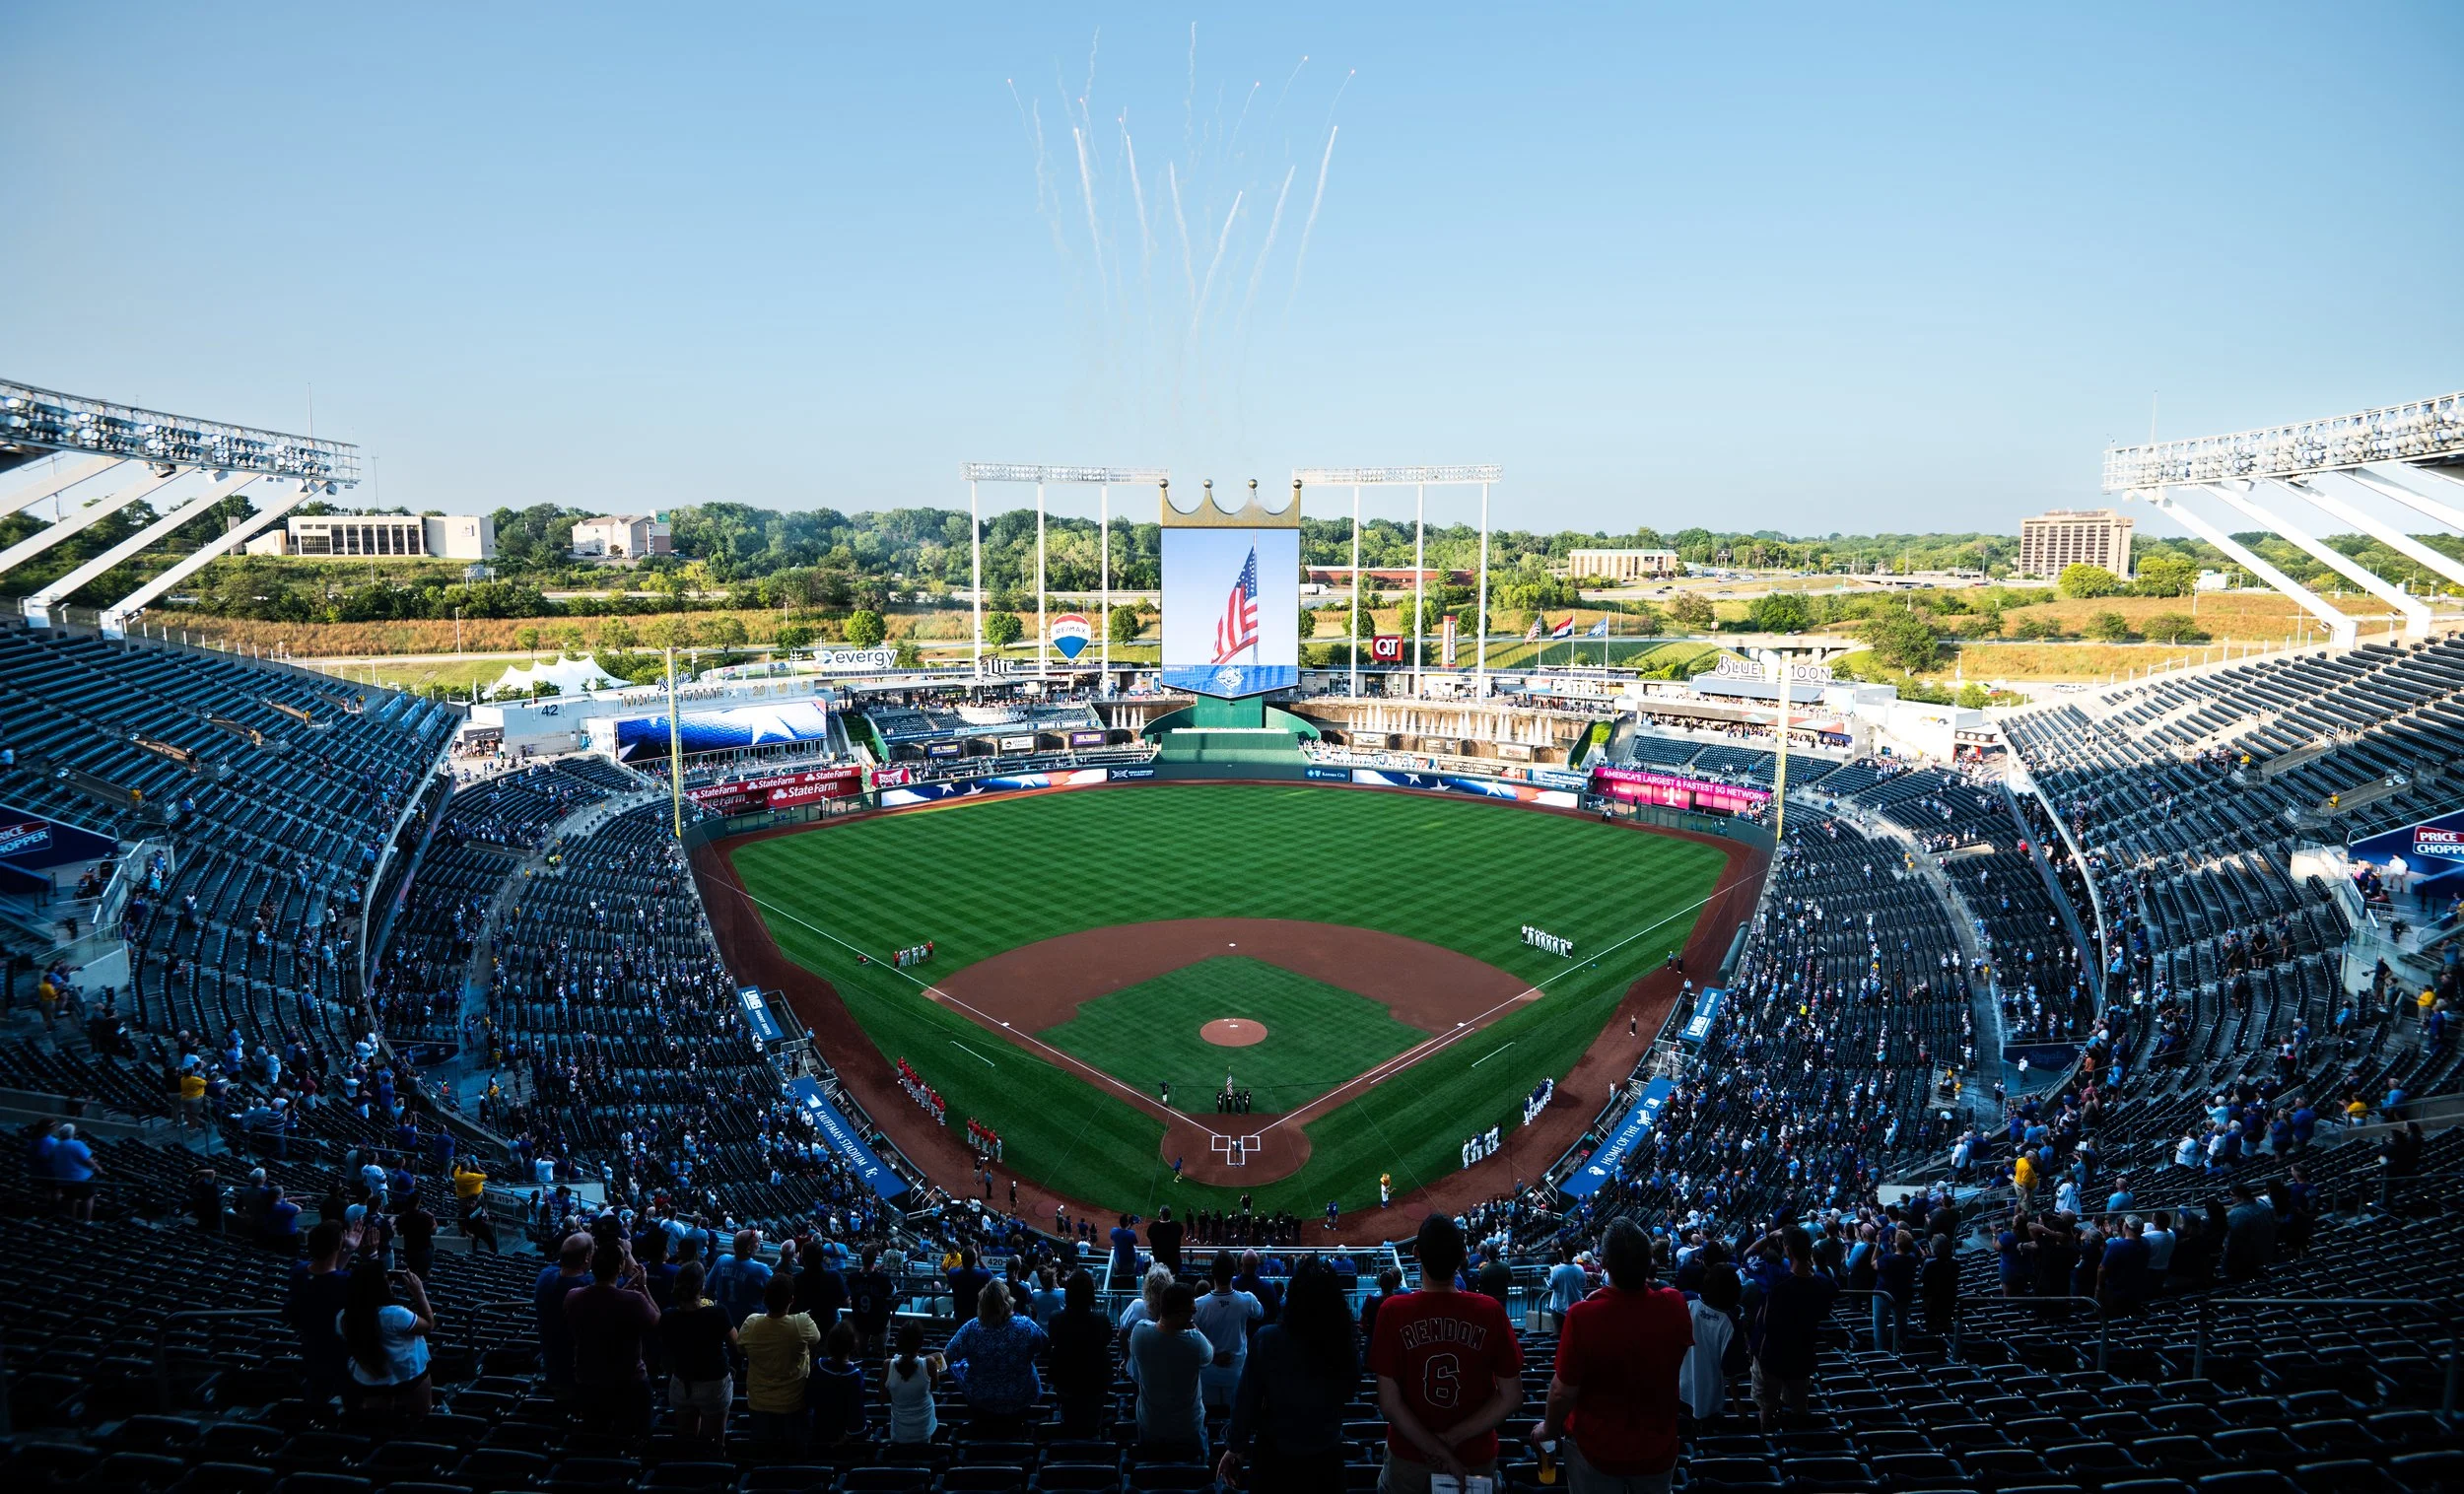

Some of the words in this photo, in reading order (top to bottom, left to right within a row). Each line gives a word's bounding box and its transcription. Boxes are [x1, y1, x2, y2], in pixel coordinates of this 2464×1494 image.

[1056, 626, 1086, 635] RE/MAX
[1375, 638, 1399, 656] QT
[835, 650, 896, 668] evergy
[987, 658, 1015, 677] Lite
[1716, 655, 1759, 676] BLUE
[753, 685, 766, 696] 20
[777, 682, 787, 694] 10
[801, 680, 808, 691] 5
[622, 693, 667, 708] HALL
[682, 686, 724, 702] FAME
[541, 704, 559, 716] 42
[880, 774, 900, 783] SONIC
[1604, 770, 1643, 781] AMERICA'S
[1643, 776, 1675, 787] LARGEST
[1682, 781, 1714, 792] FASTEST
[0, 826, 26, 842] RICE
[0, 831, 48, 854] HOPPER
[2419, 832, 2458, 843] PRICE
[745, 989, 764, 1010] UMB
[1686, 1015, 1707, 1037] UMB
[815, 1110, 847, 1140] KAUFFMAN
[839, 1138, 867, 1167] STADIUM
[1600, 1144, 1623, 1166] HOME
[1616, 1135, 1629, 1146] OF
[1624, 1124, 1640, 1138] THE
[988, 1257, 1003, 1266] 420
[859, 1295, 871, 1314] 9
[1400, 1317, 1487, 1351] RENDON
[1422, 1352, 1461, 1409] 6
